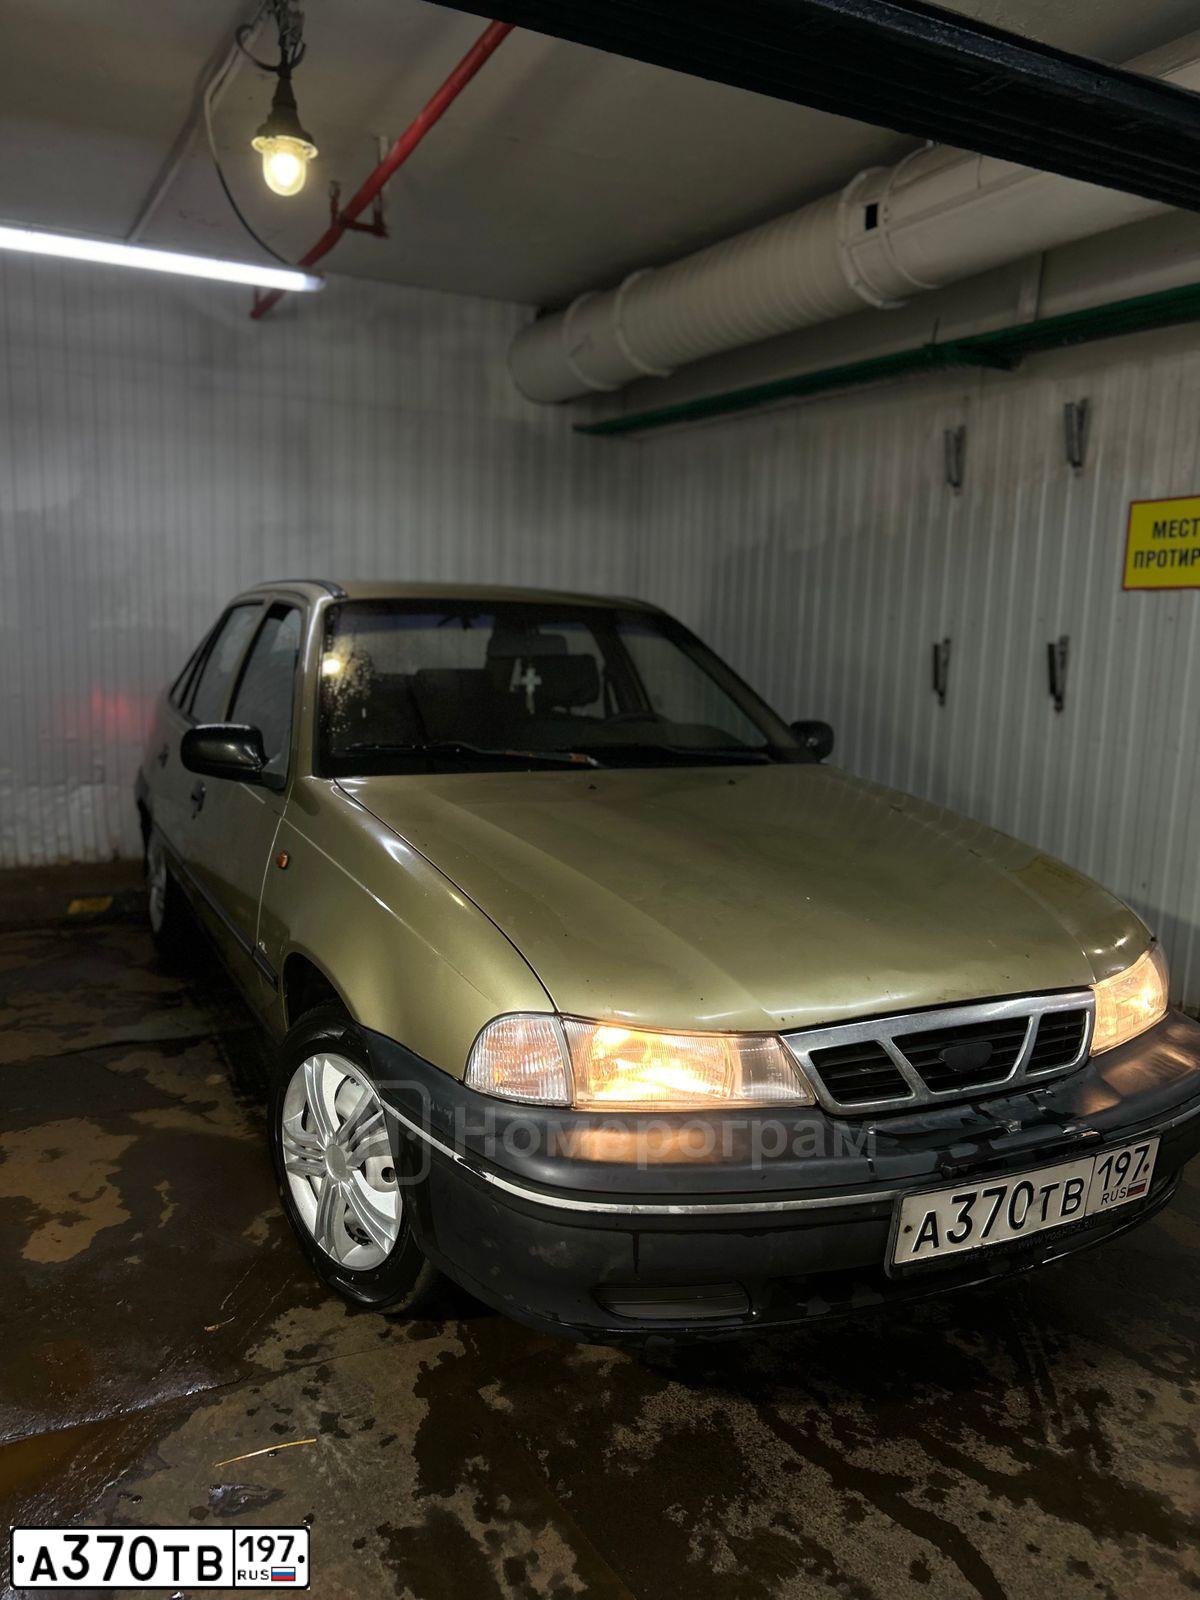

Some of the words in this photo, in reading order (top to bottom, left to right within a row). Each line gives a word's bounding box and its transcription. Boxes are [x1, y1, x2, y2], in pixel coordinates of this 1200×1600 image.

[1152, 518, 1200, 540] МЕСТ
[1133, 548, 1200, 569] ПРОТИР
[1097, 1144, 1151, 1191] 197
[1100, 1186, 1127, 1206] RUS
[911, 1177, 1085, 1253] А370ТВ
